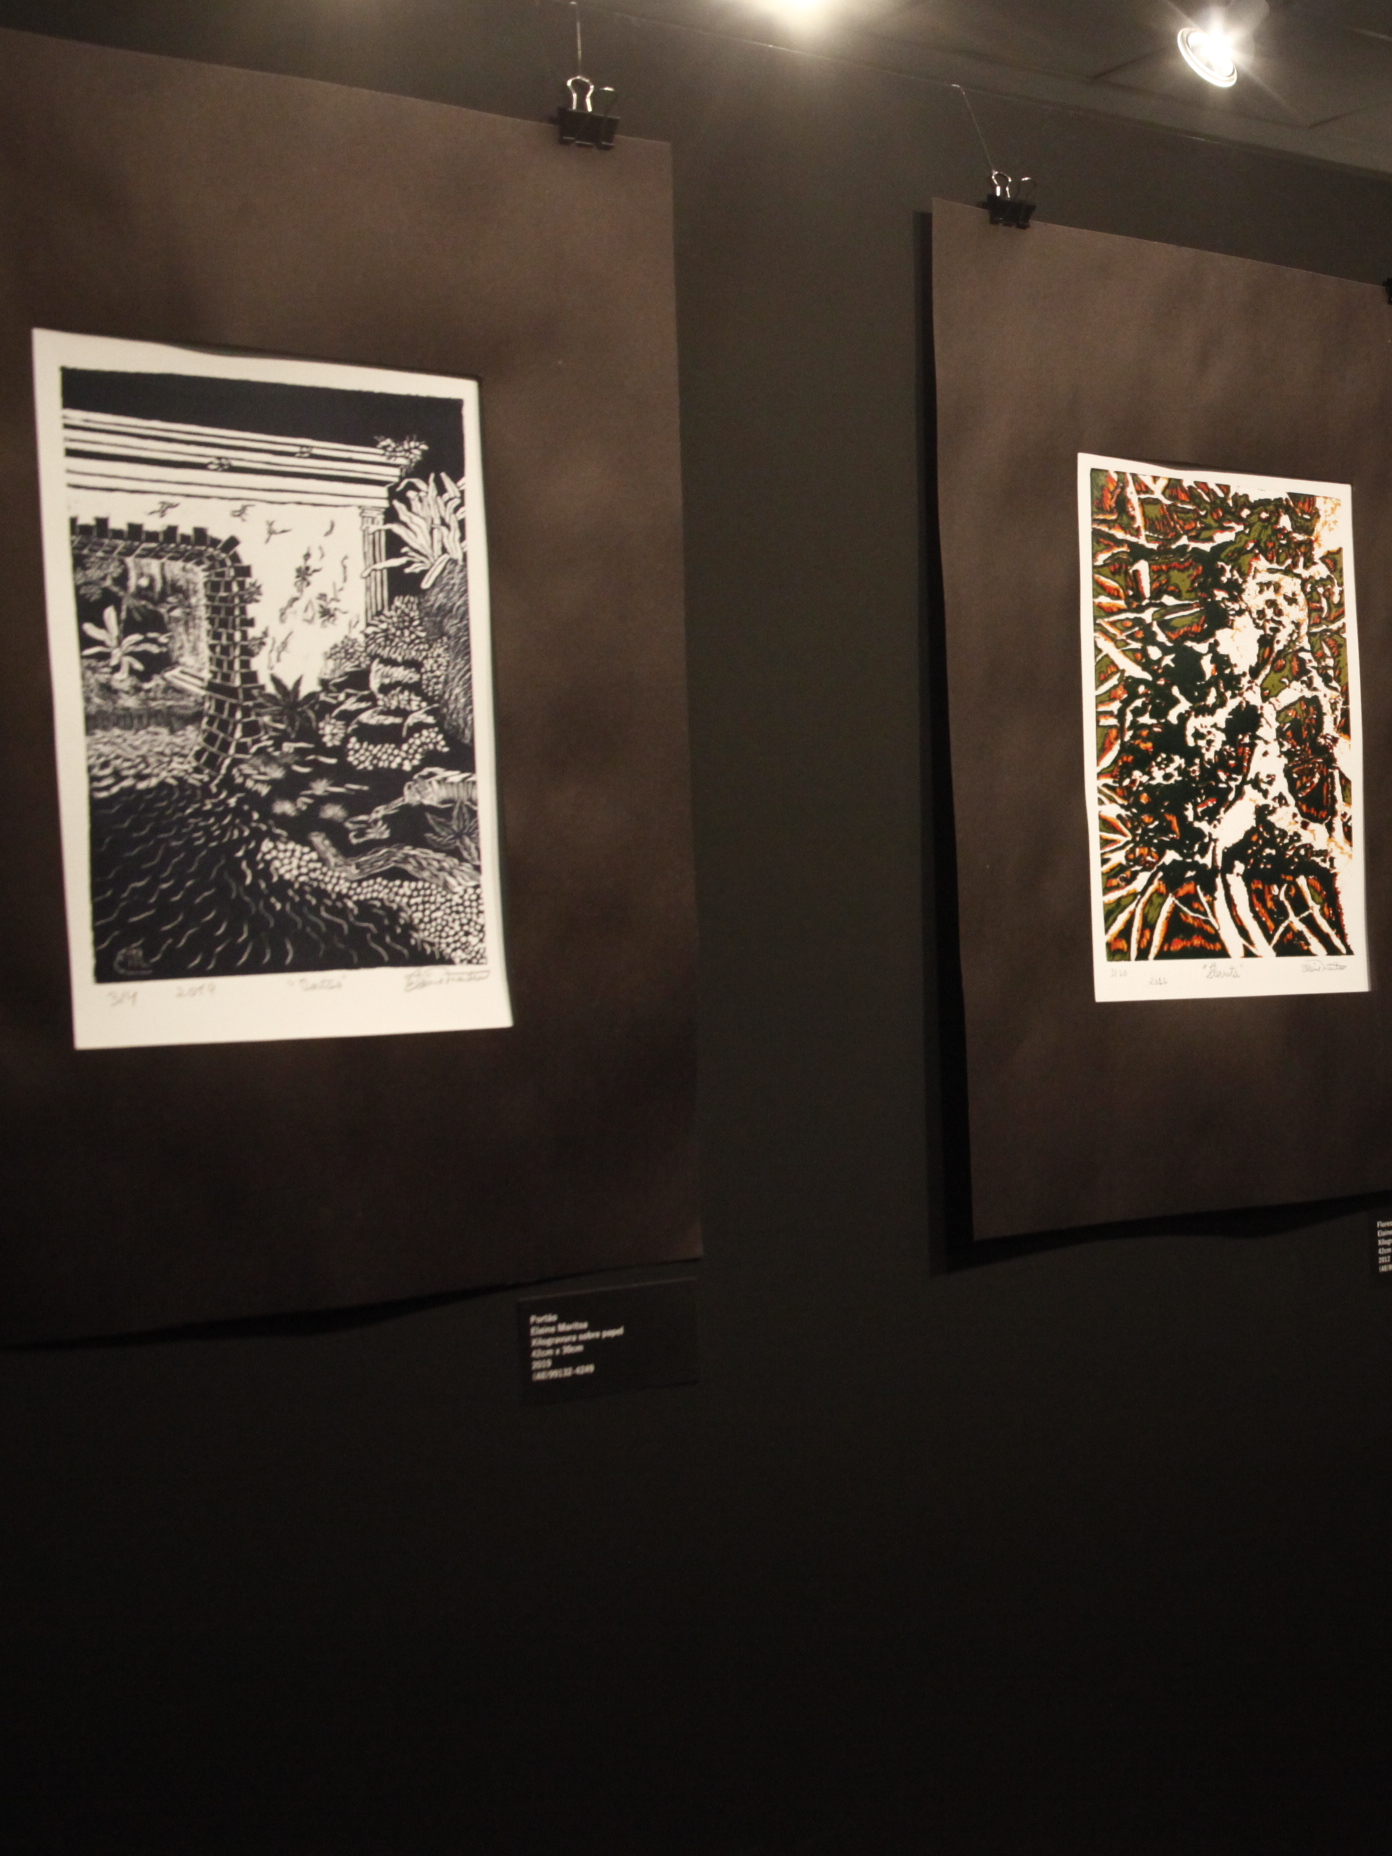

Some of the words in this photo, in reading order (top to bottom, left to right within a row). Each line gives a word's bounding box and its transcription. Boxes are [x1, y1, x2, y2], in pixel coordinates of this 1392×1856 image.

[1379, 1256, 1391, 1264] 2017
[530, 1326, 556, 1336] Elaine
[578, 1330, 600, 1341] sobre
[602, 1326, 624, 1339] papel
